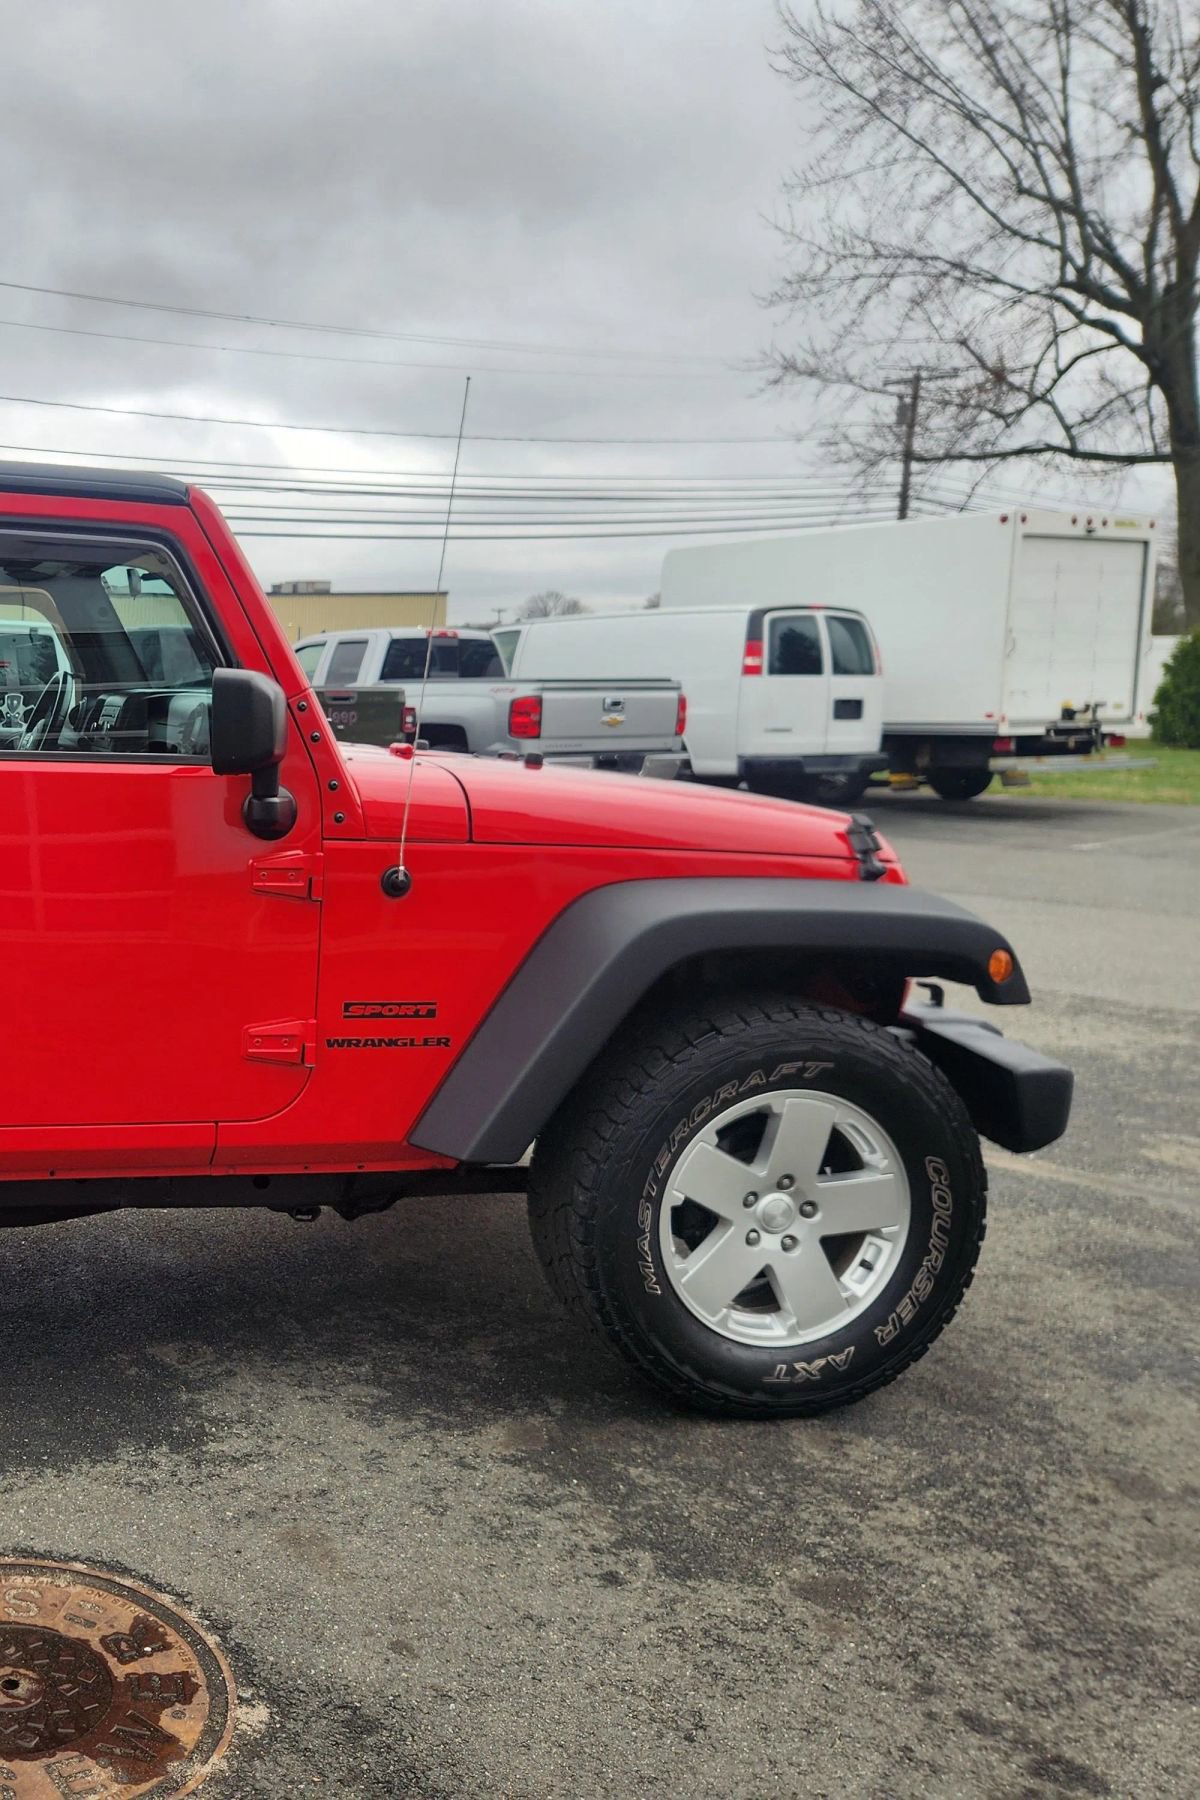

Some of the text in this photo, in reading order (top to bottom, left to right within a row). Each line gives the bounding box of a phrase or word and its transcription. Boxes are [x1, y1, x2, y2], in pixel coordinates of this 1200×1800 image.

[326, 1037, 451, 1048] WRANGLER
[345, 1004, 434, 1017] SPORT
[635, 1061, 835, 1296] MASTERCRAFT
[762, 1155, 954, 1383] COURSER AXT
